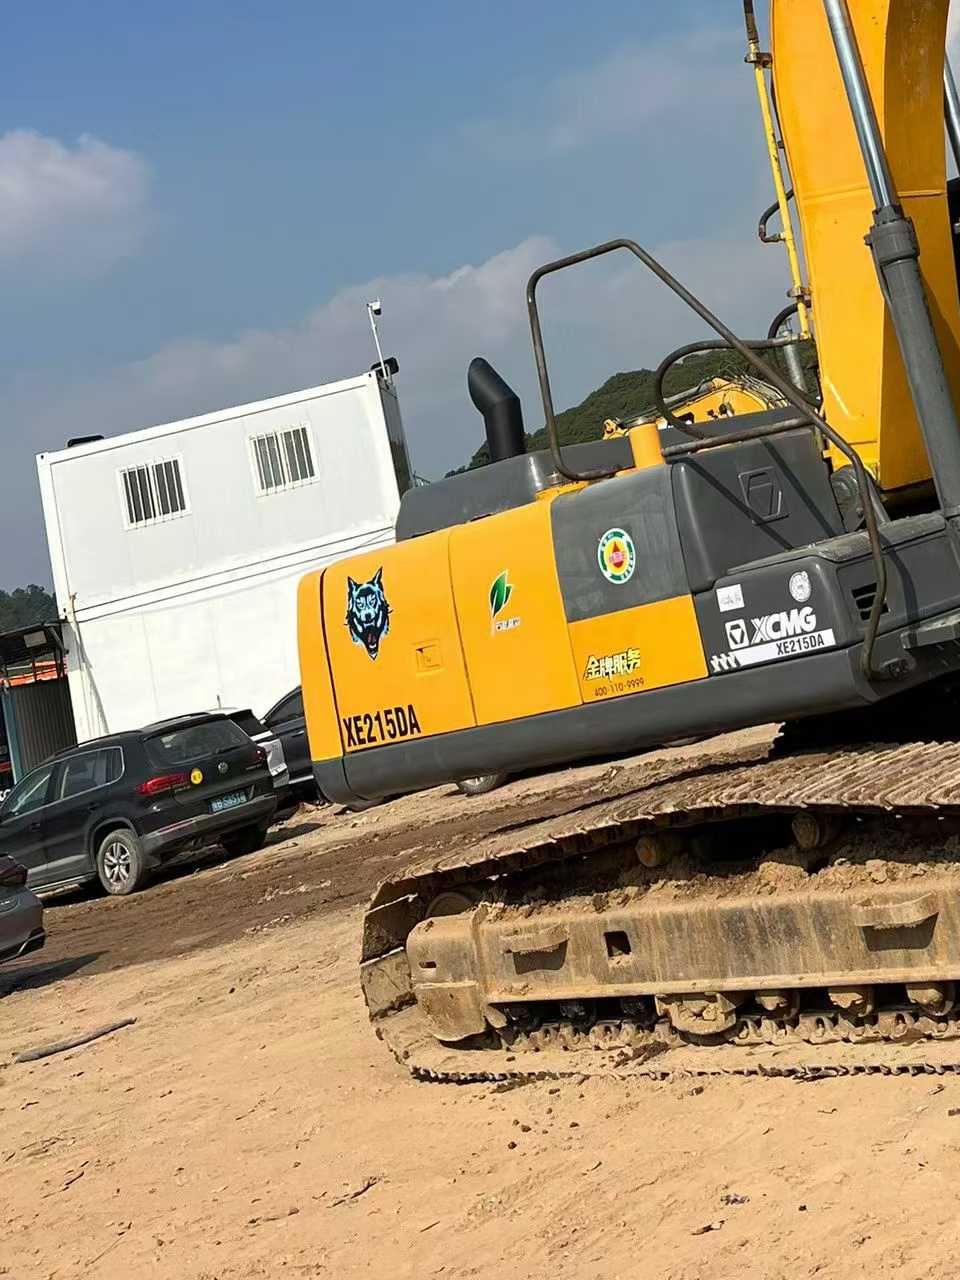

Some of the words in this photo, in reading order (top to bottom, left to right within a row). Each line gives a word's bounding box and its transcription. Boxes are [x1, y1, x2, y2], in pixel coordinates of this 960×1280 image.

[751, 606, 817, 645] XCMG
[776, 632, 825, 656] XE215DA
[583, 647, 641, 682] 金牌服务
[342, 704, 422, 748] XE215DA
